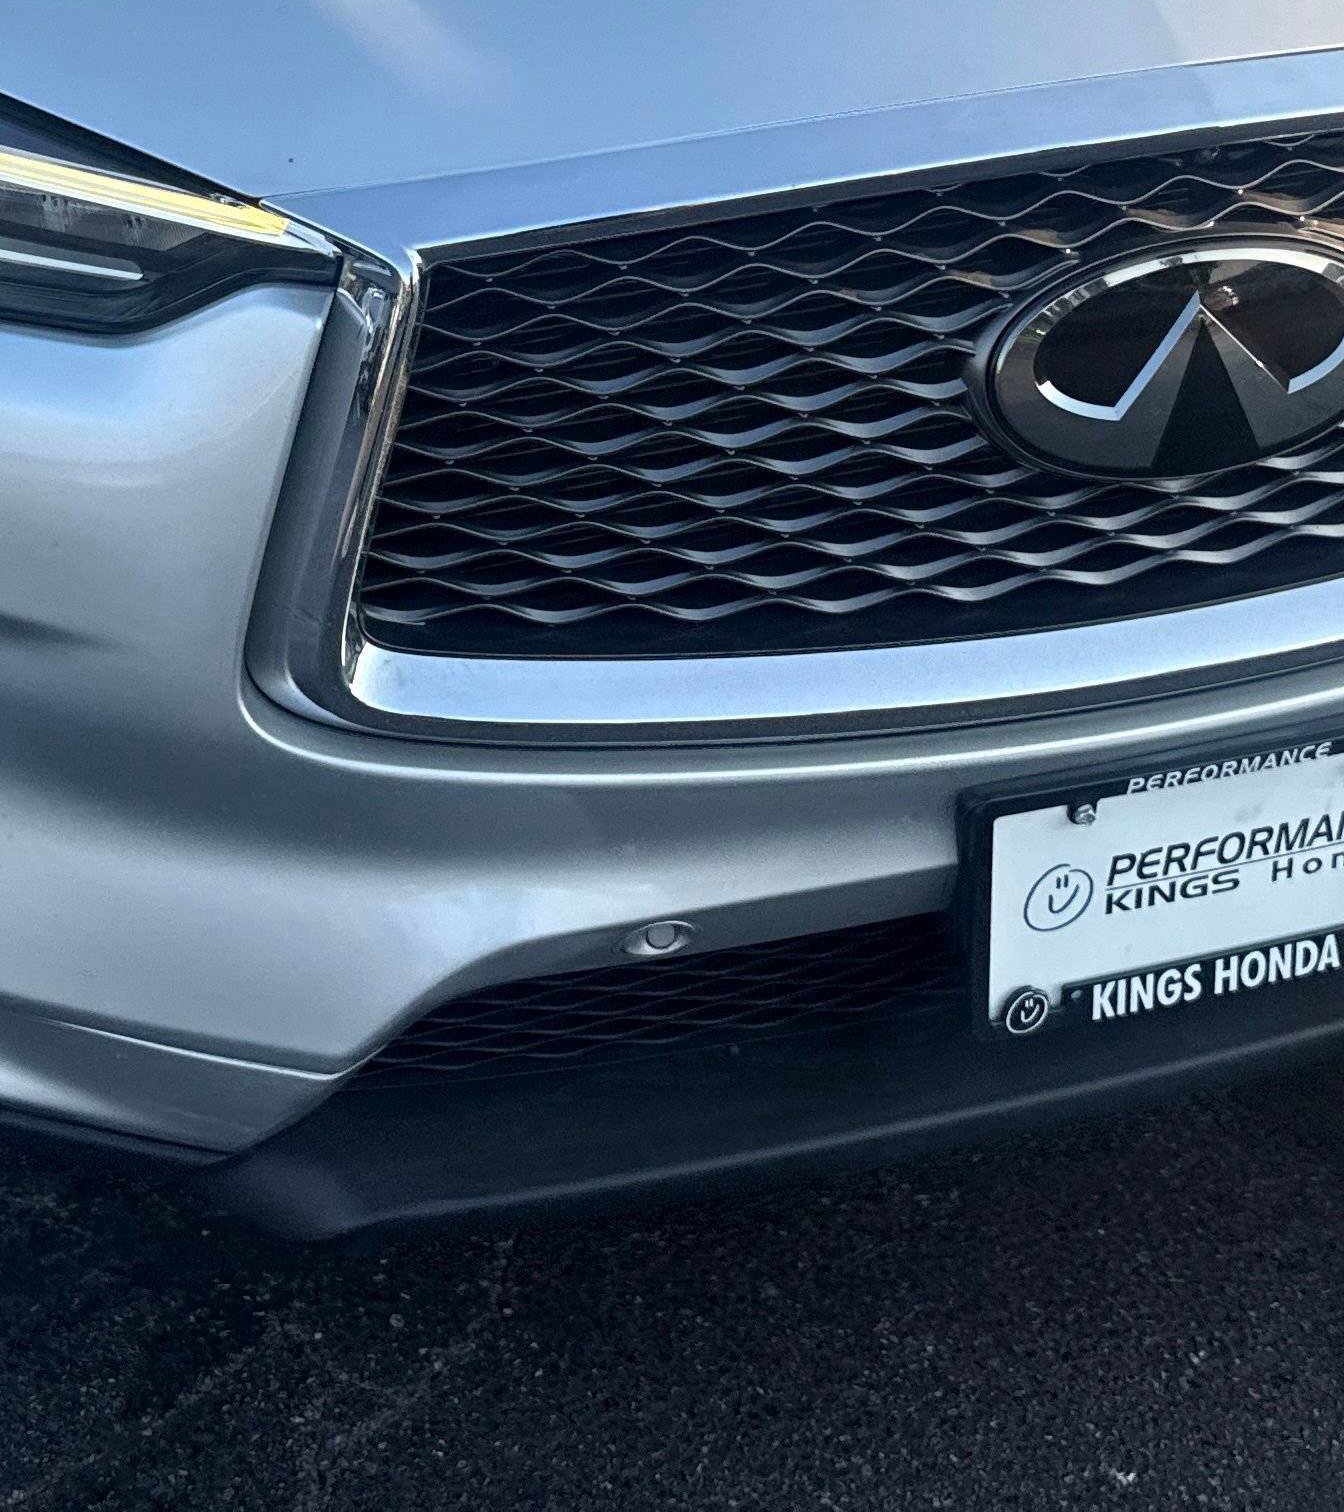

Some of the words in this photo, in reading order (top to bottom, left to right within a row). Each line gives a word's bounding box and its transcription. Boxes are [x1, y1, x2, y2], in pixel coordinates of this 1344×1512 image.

[1126, 741, 1334, 795] PERFORMANCE
[1105, 869, 1240, 915] KINGS
[1092, 963, 1203, 1021] KINGS
[1214, 934, 1342, 995] HONDA
